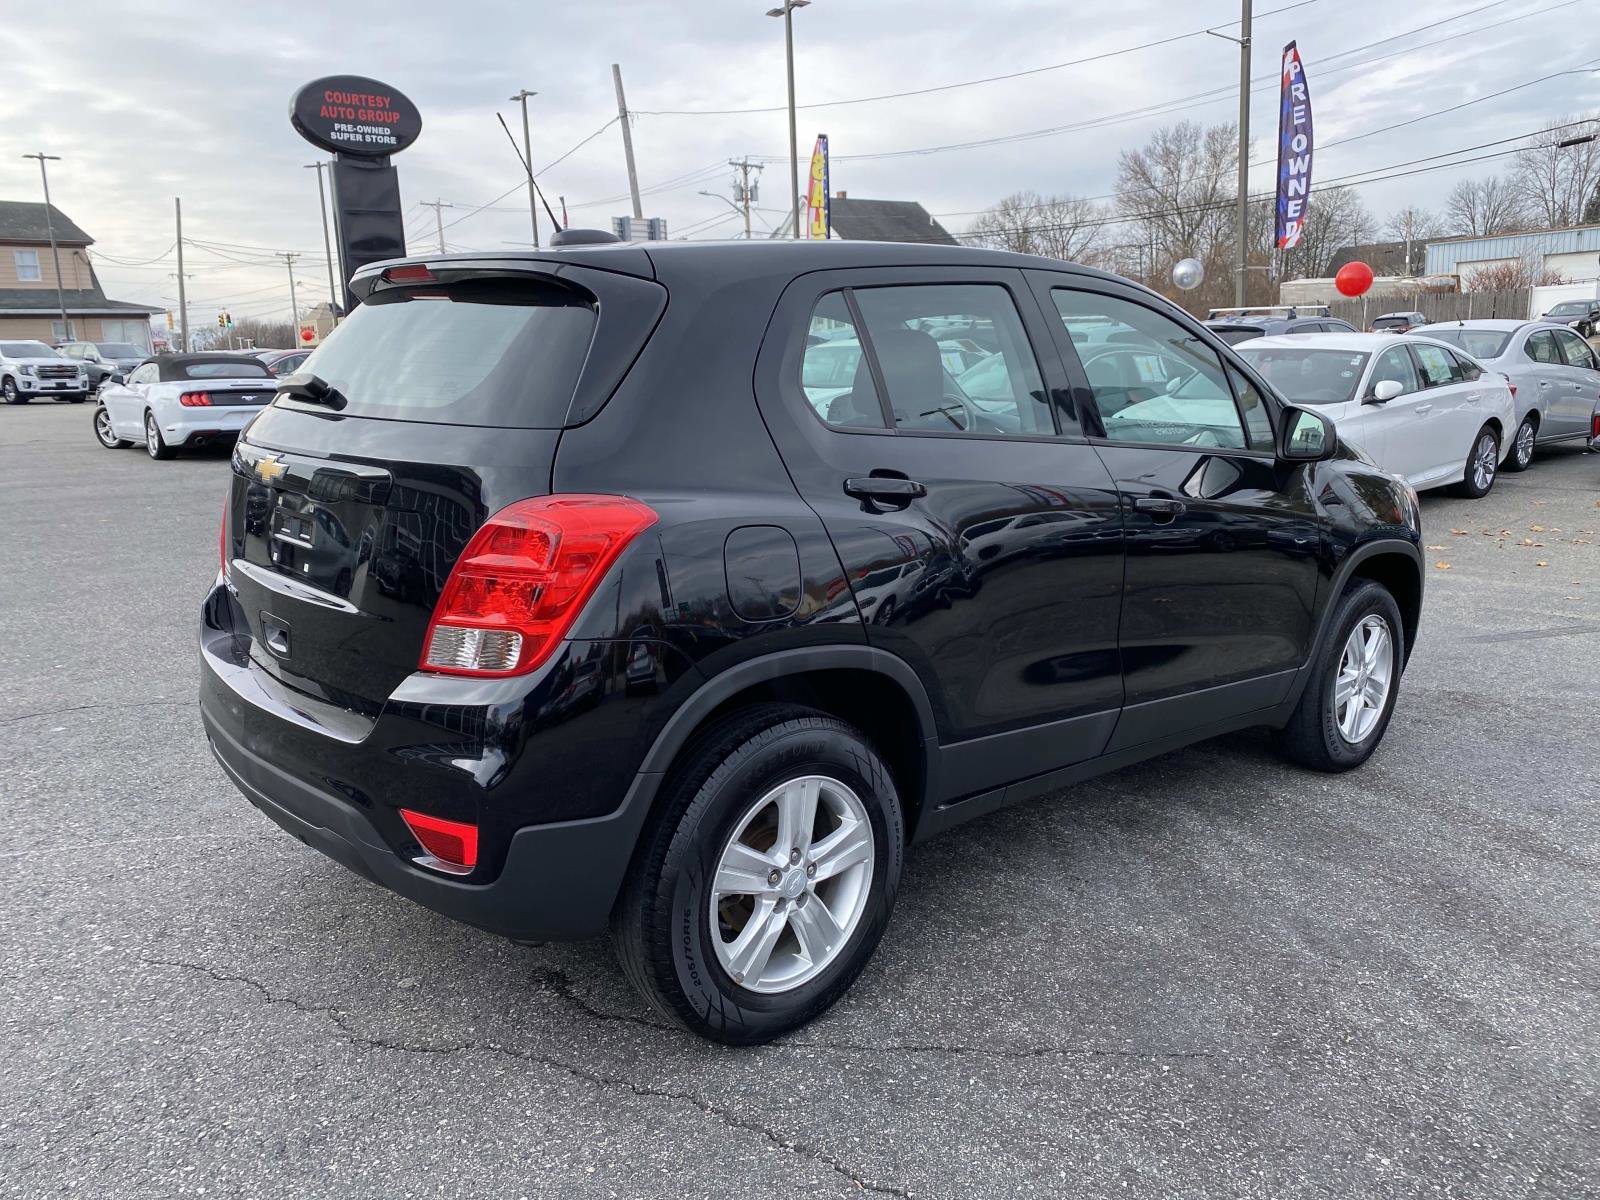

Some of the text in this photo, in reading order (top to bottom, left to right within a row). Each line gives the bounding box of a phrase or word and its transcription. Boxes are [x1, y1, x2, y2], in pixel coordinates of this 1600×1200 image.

[324, 90, 391, 109] COURTESY
[320, 105, 400, 124] AUTO GROUP
[330, 131, 397, 145] SUPER STORE
[334, 123, 391, 136] PRE-OWNED
[1286, 61, 1311, 240] PRE OWNED
